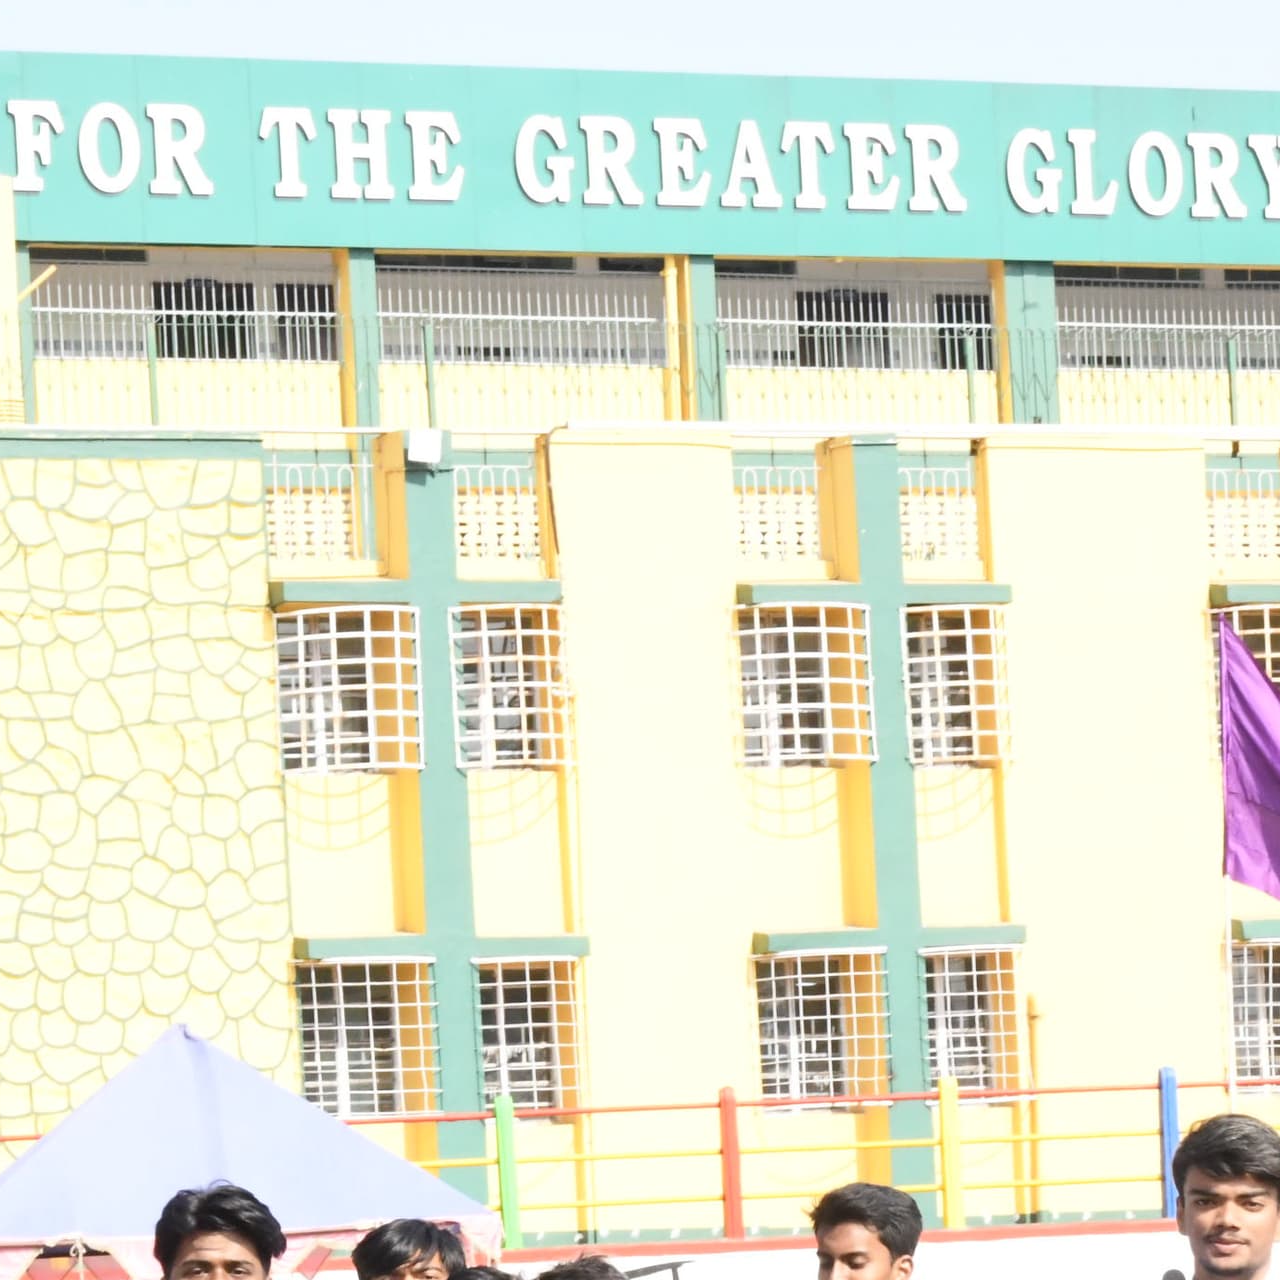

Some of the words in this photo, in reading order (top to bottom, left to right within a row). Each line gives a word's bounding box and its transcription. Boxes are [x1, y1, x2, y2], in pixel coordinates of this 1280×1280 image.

[6, 98, 216, 196] FOR
[259, 106, 466, 201] THE
[514, 114, 969, 213] GREATER
